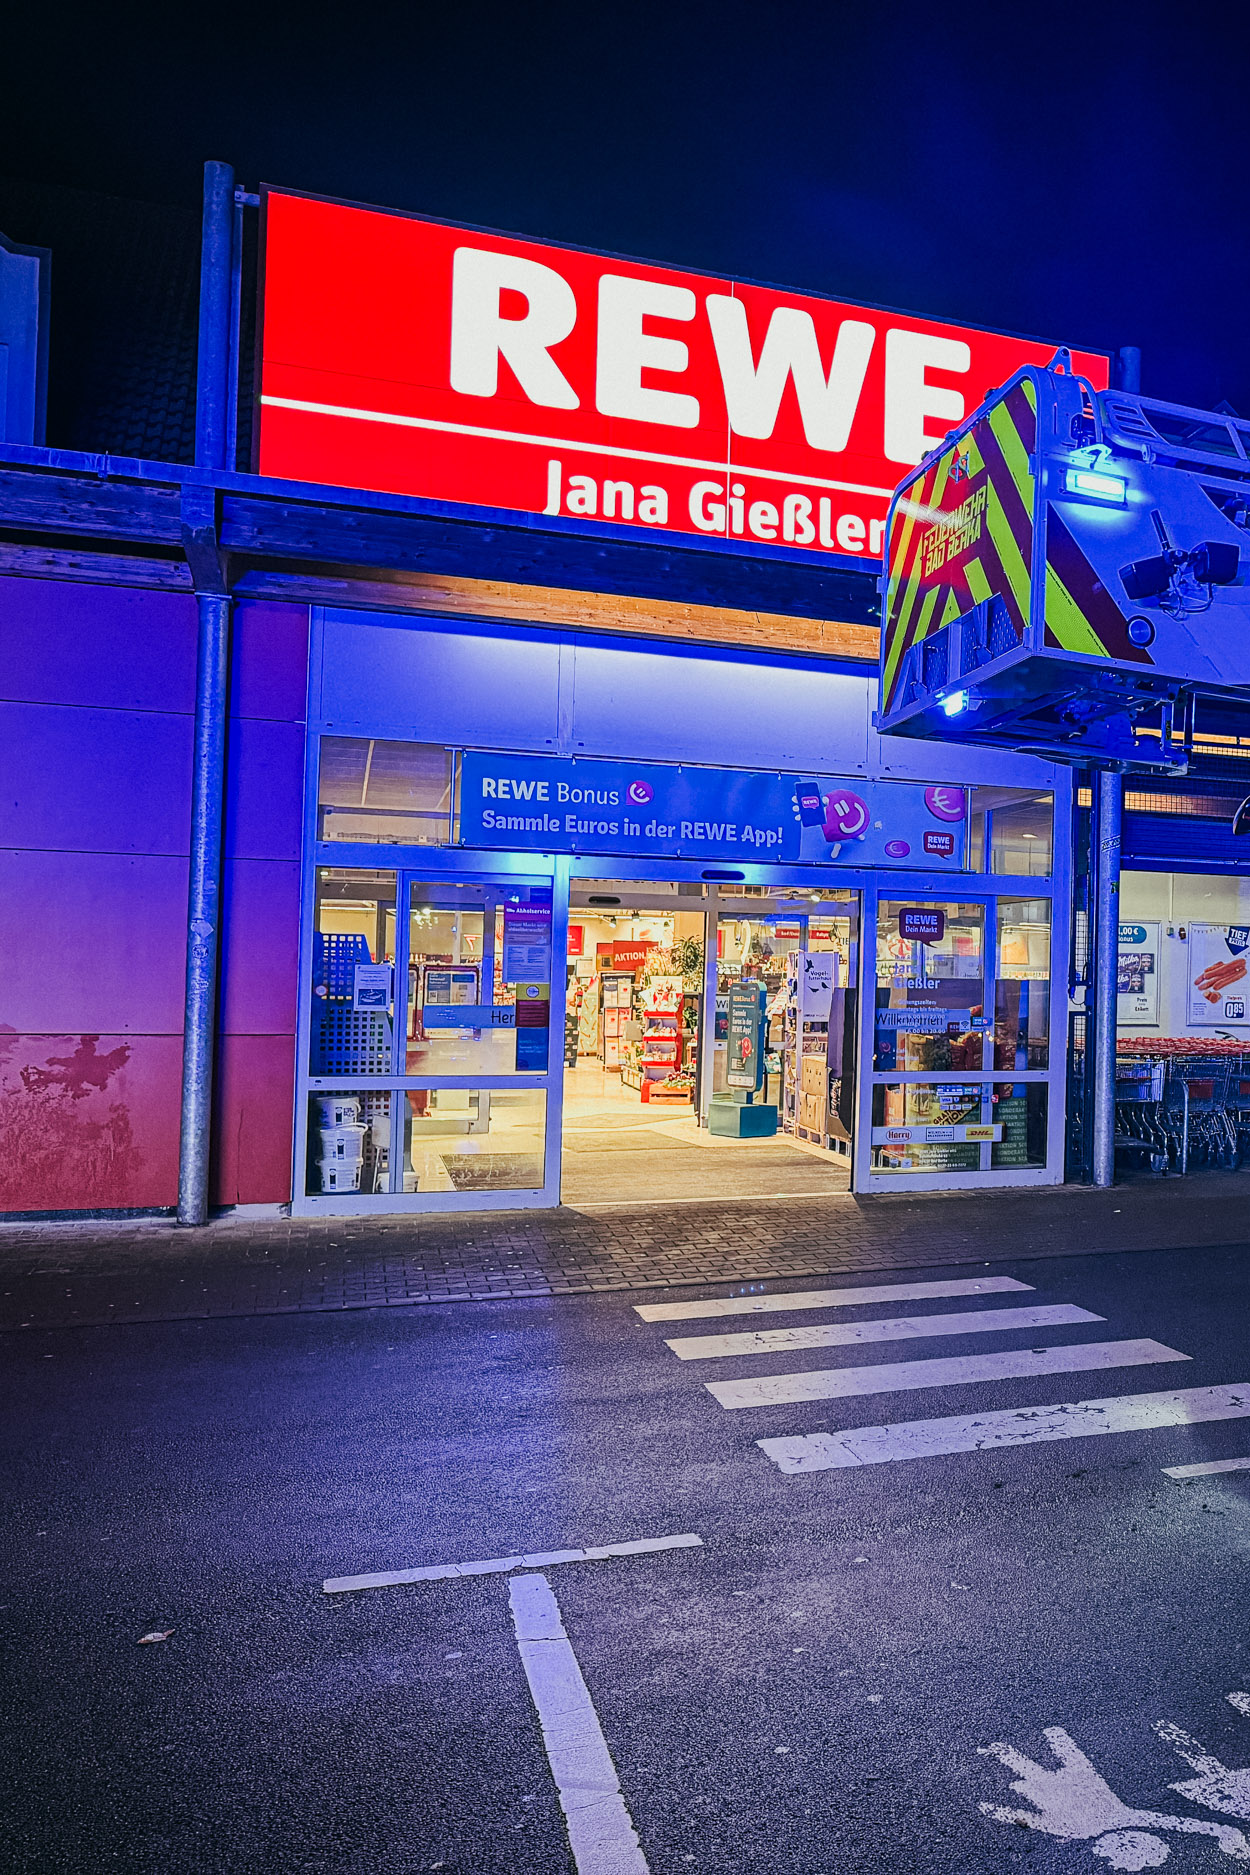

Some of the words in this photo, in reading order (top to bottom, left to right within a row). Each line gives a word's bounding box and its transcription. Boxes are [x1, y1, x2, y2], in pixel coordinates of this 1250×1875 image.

[450, 246, 971, 465] REWE
[543, 459, 670, 527] Jana
[688, 479, 888, 555] Gießler
[923, 485, 987, 557] FEUERWEHR
[925, 542, 945, 578] BAD
[947, 514, 981, 562] BERKA
[482, 777, 549, 801] REWE
[557, 782, 619, 806] Bonus
[482, 810, 560, 833] Sammle
[565, 816, 619, 835] Euros
[624, 817, 640, 835] in
[645, 818, 676, 838] der
[680, 822, 737, 842] REWE
[741, 823, 783, 848] App!
[927, 835, 950, 844] REWE
[905, 915, 938, 925] REWE
[905, 925, 918, 933] Dein
[1133, 927, 1139, 935] €
[1231, 929, 1247, 940] TIEF
[614, 952, 645, 962] AKTION
[491, 1010, 515, 1025] Her
[888, 1130, 910, 1139] Harry
